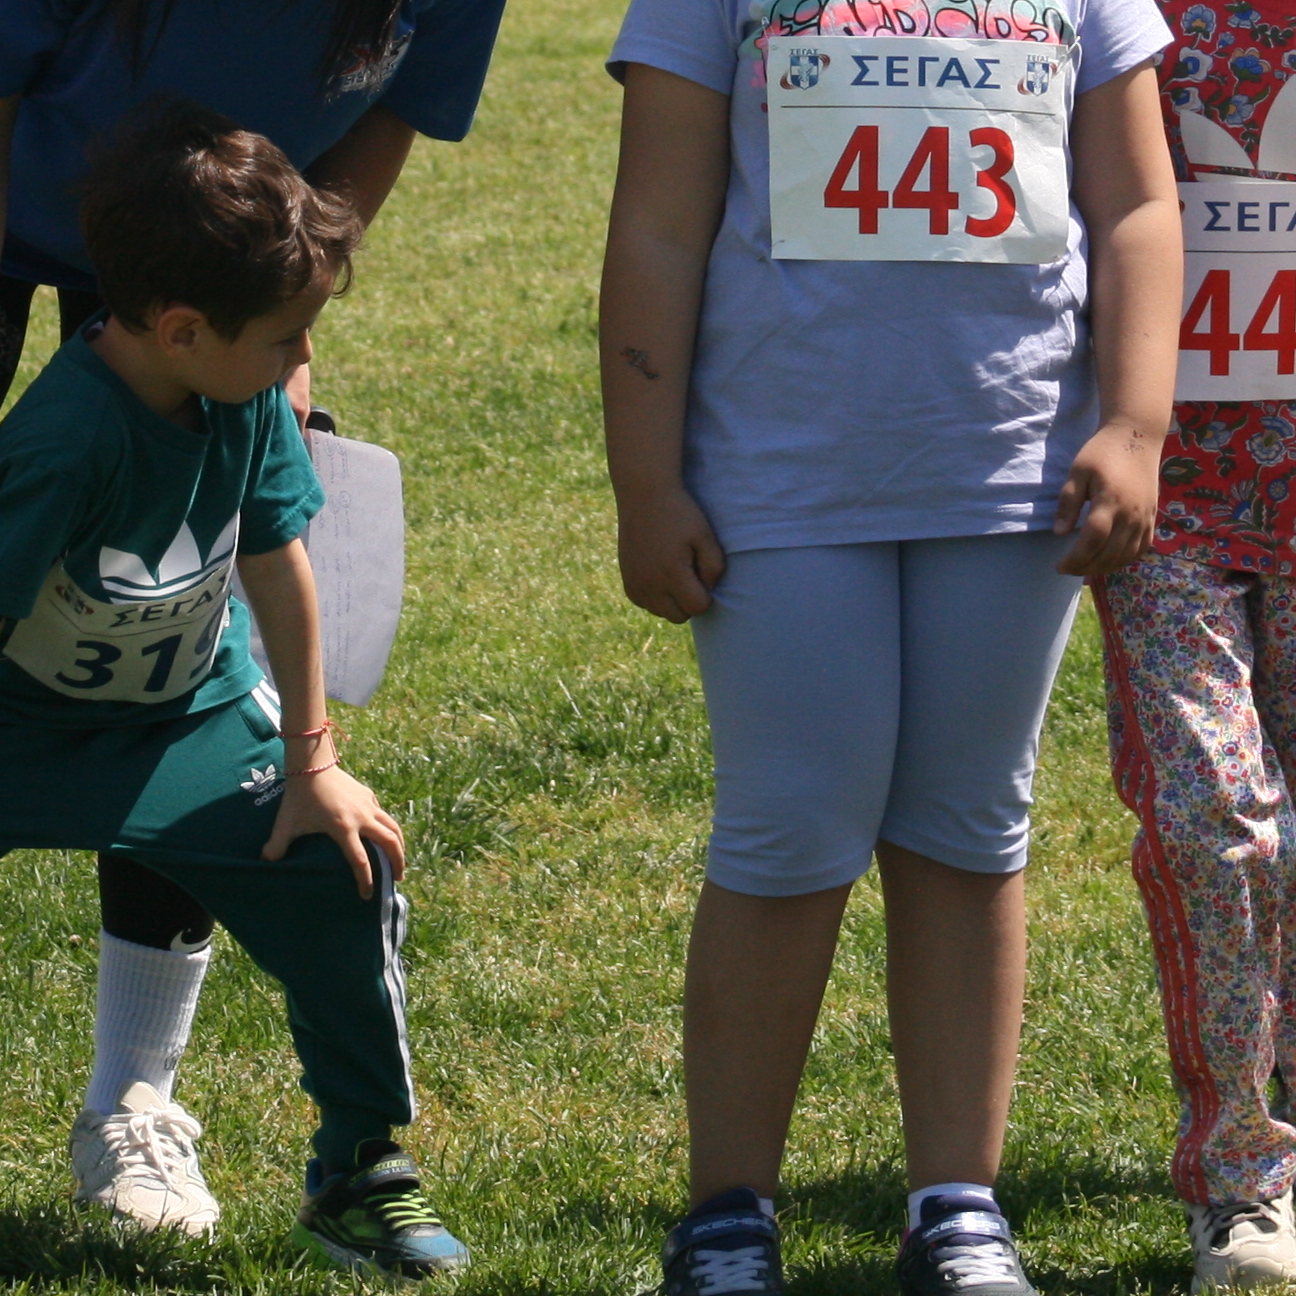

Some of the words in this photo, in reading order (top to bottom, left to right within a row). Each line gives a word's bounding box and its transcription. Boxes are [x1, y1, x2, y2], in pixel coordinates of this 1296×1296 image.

[850, 54, 1001, 90] ΣΕΓΑΣ
[823, 124, 1018, 239] 443
[254, 784, 285, 806] adida
